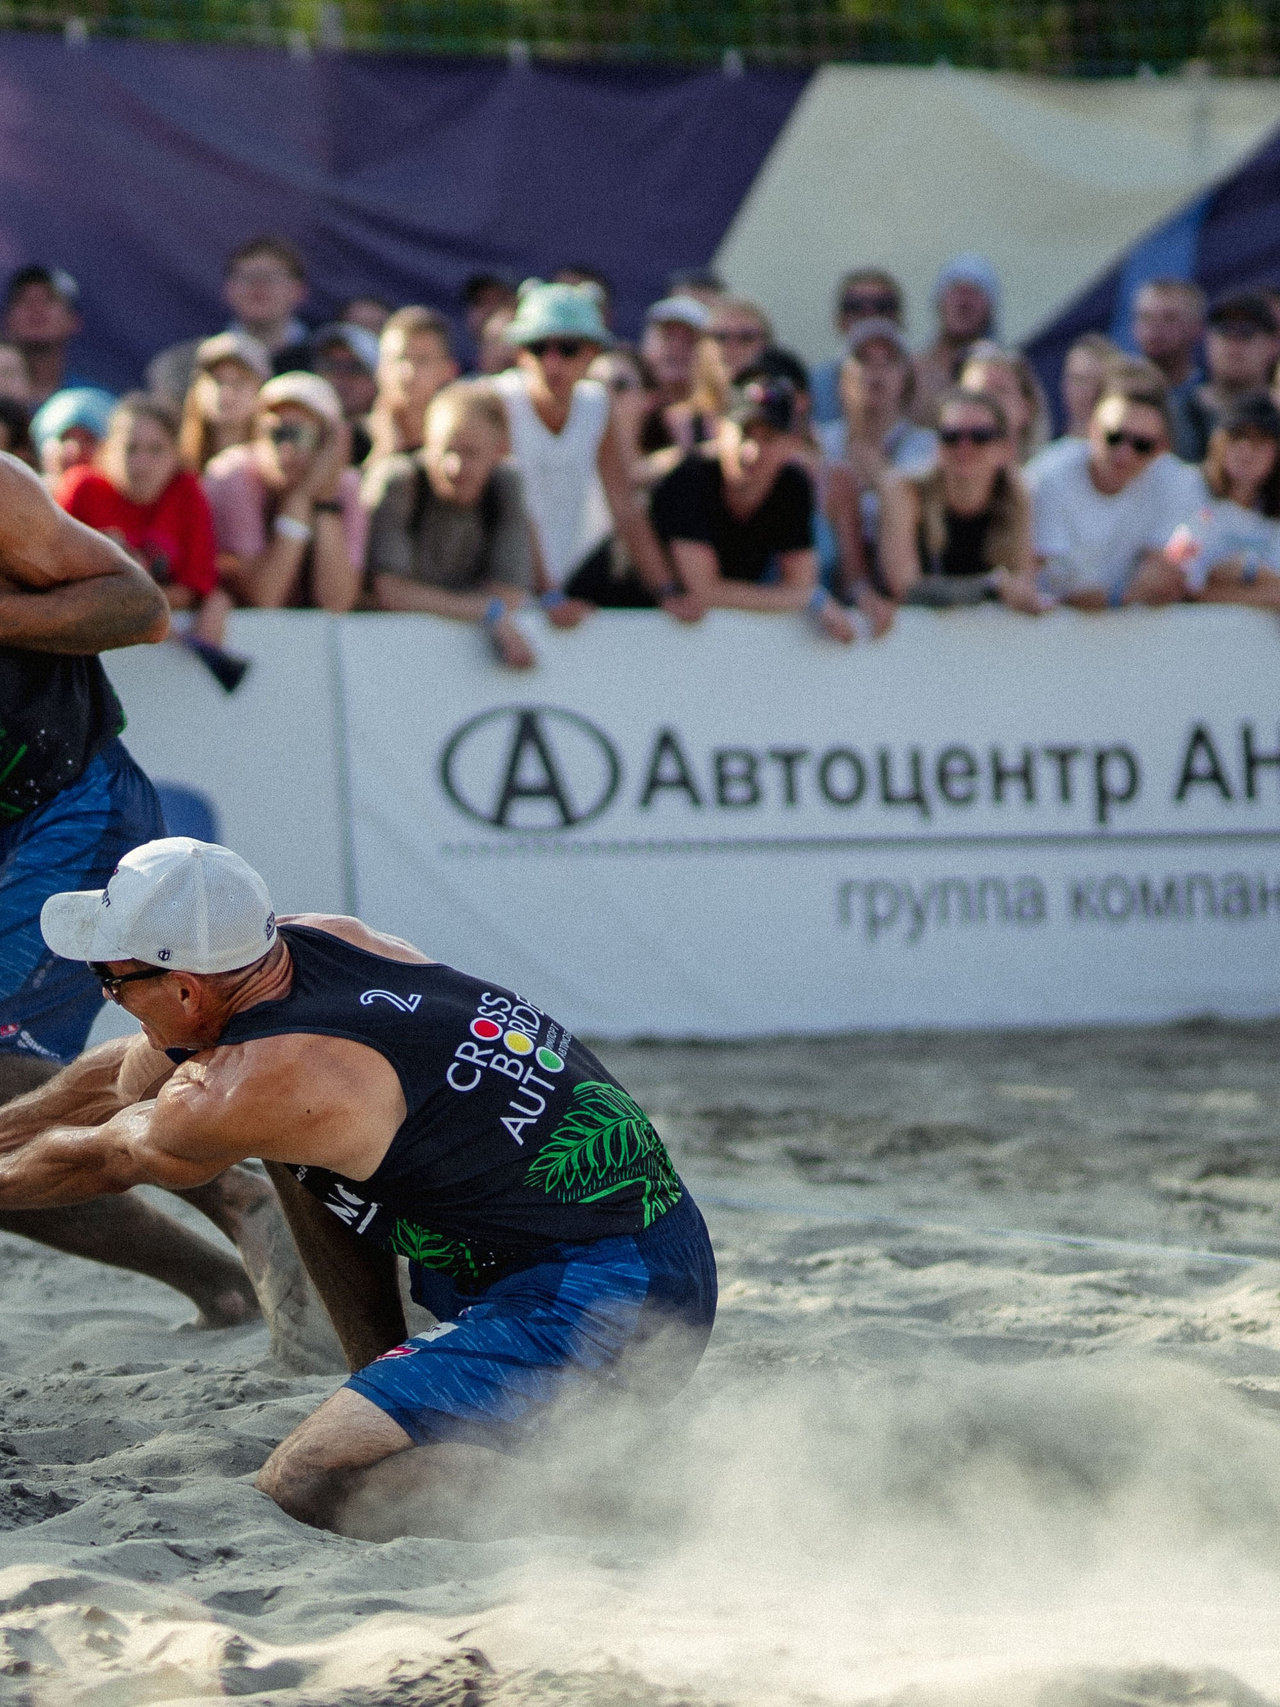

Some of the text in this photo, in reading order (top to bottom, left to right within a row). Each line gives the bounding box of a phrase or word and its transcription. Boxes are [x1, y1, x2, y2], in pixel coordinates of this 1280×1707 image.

[640, 725, 1140, 827] Автоцентр
[836, 873, 1048, 946] группа
[359, 988, 422, 1013] 2
[446, 991, 512, 1092] CROSS
[499, 1046, 565, 1146] AUTO
